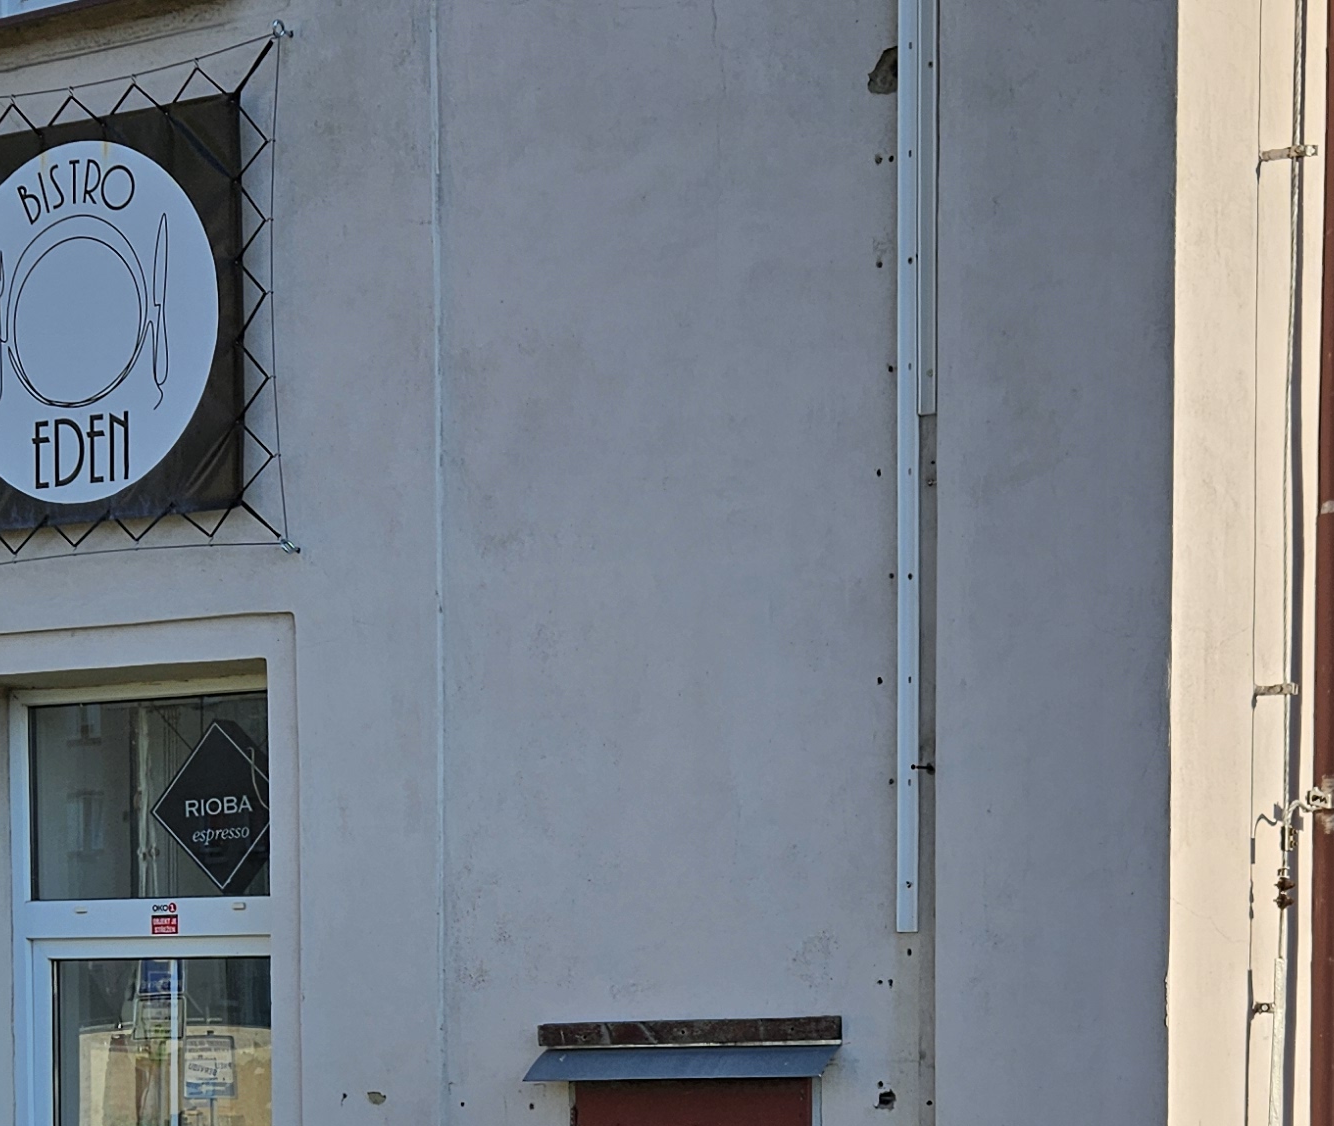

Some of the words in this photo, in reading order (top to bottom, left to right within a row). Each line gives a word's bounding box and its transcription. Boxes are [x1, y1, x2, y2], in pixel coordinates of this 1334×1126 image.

[17, 158, 135, 226] BISTRO
[32, 410, 130, 490] EDEN
[185, 794, 253, 818] RIOBA
[192, 826, 250, 846] espresso
